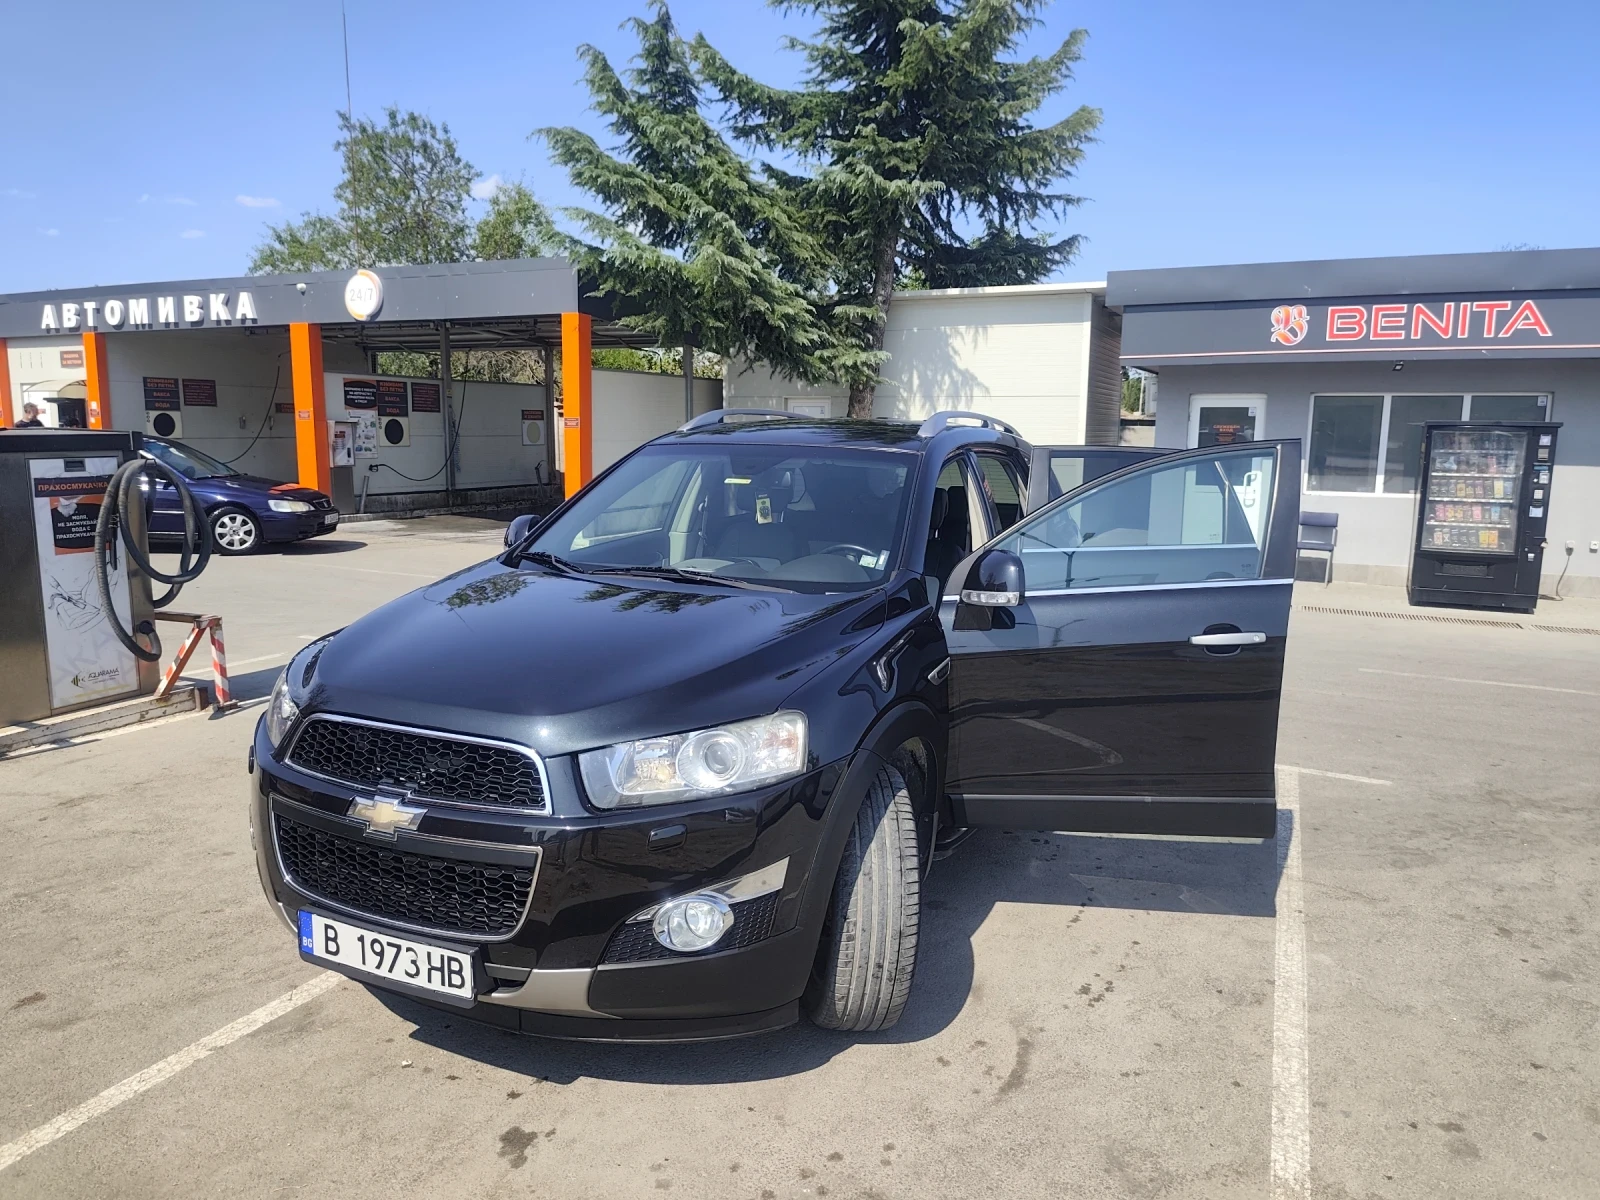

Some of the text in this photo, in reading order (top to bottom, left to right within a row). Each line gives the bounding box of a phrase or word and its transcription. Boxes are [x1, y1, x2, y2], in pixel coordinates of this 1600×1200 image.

[350, 288, 373, 302] 24/7
[41, 292, 258, 330] АВТОМИВКА
[1326, 299, 1553, 341] BENITA
[37, 481, 109, 491] ПРАХОСМУКАЧКА
[66, 518, 99, 527] ЗАСМУКВАЙ
[88, 667, 120, 679] AQUARAMA
[302, 936, 313, 948] BG
[324, 923, 466, 990] B 1973 HB
